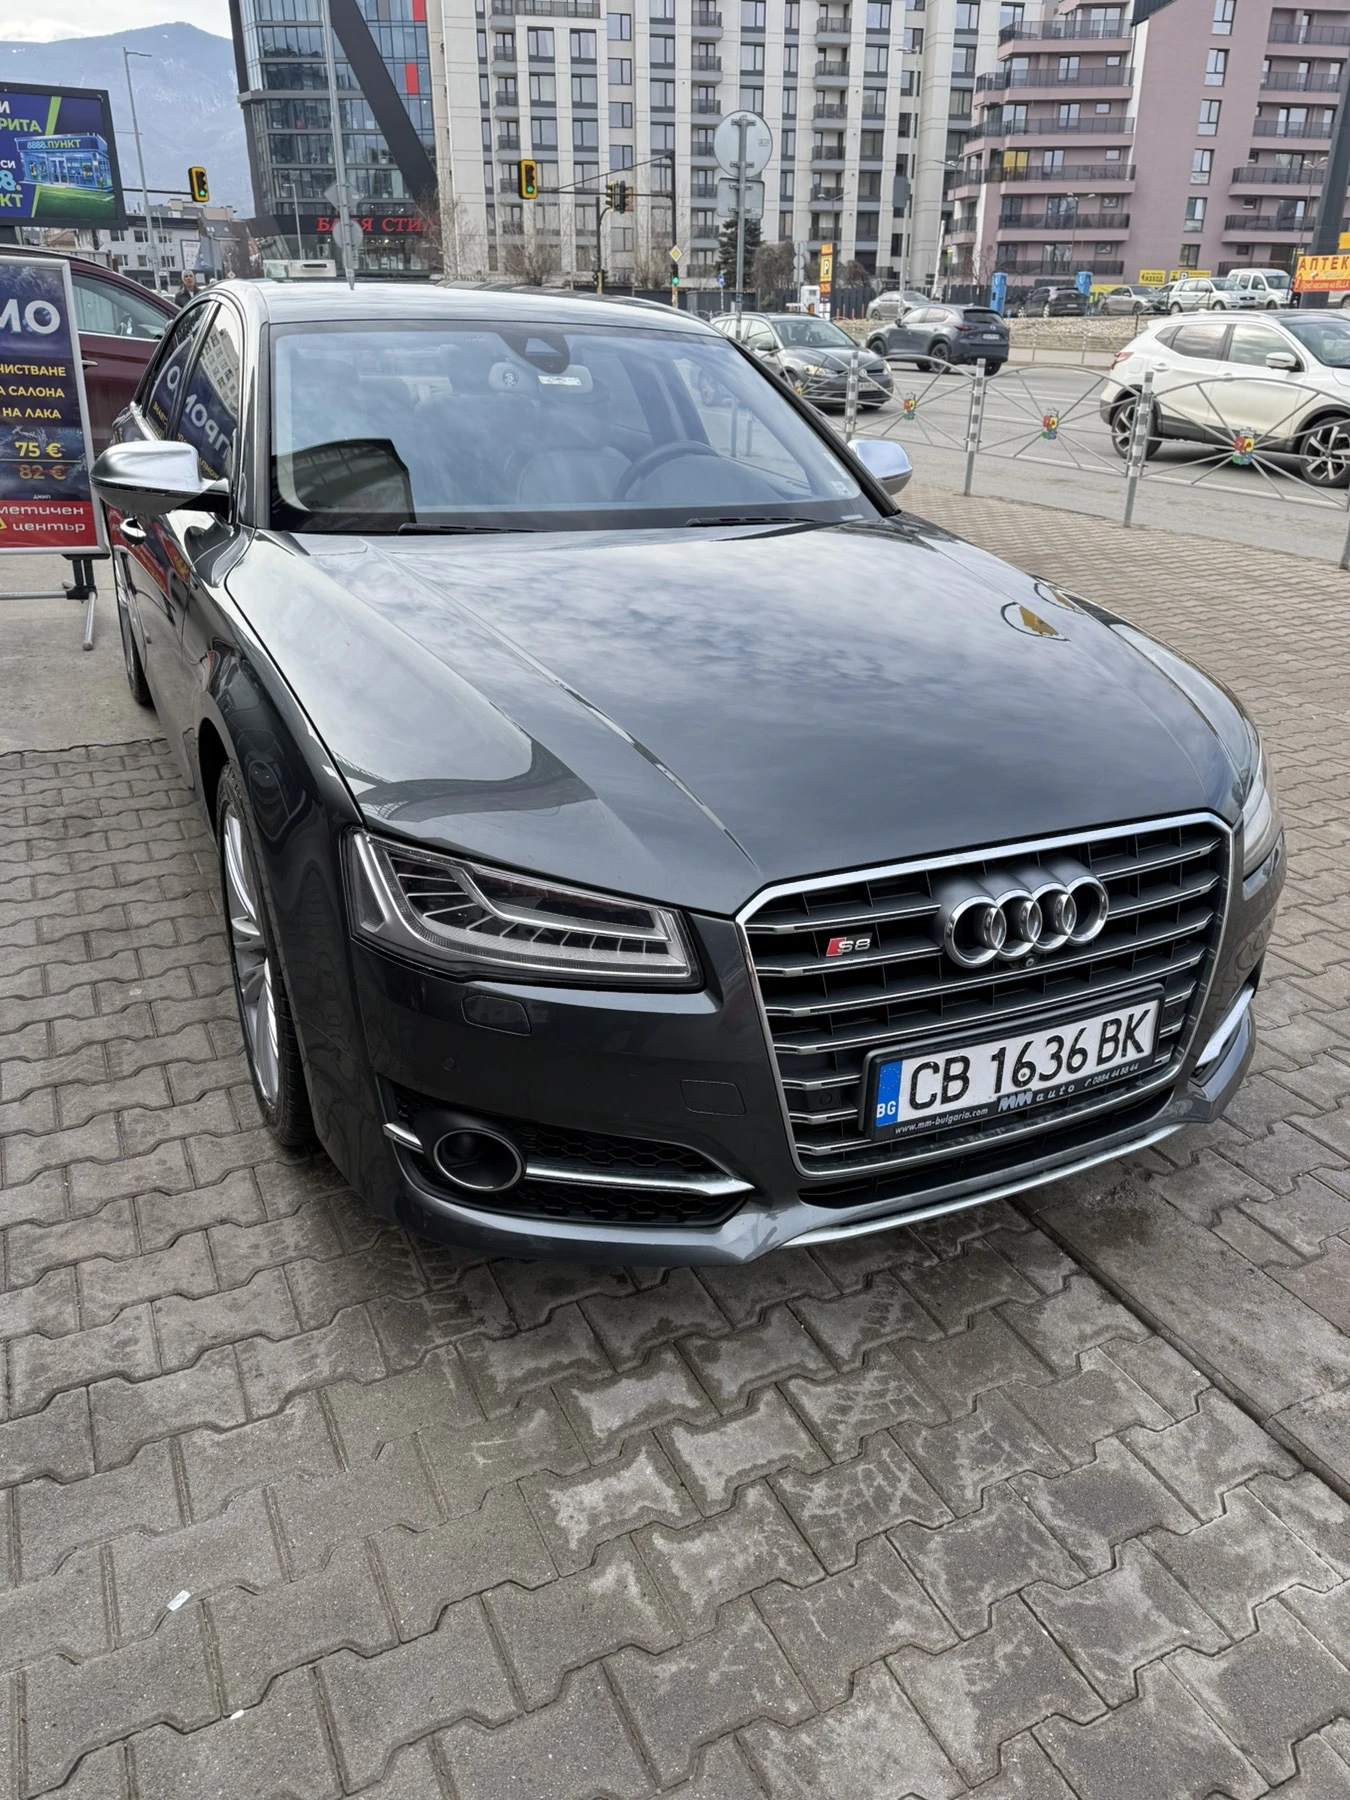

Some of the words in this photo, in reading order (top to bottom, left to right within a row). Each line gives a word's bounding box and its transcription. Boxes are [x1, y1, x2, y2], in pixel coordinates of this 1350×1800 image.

[9, 386, 65, 398] САЛОНА
[2, 407, 22, 418] НА
[25, 408, 61, 419] ЛАКА
[15, 441, 40, 458] 75
[46, 442, 62, 458] €
[19, 464, 45, 479] 82
[837, 938, 871, 953] S8
[909, 1055, 971, 1111] CB
[991, 1027, 1088, 1095] 1636
[1096, 1008, 1151, 1067] BK
[876, 1100, 897, 1118] BG
[895, 1108, 988, 1135] www.mm-bulgaria.com
